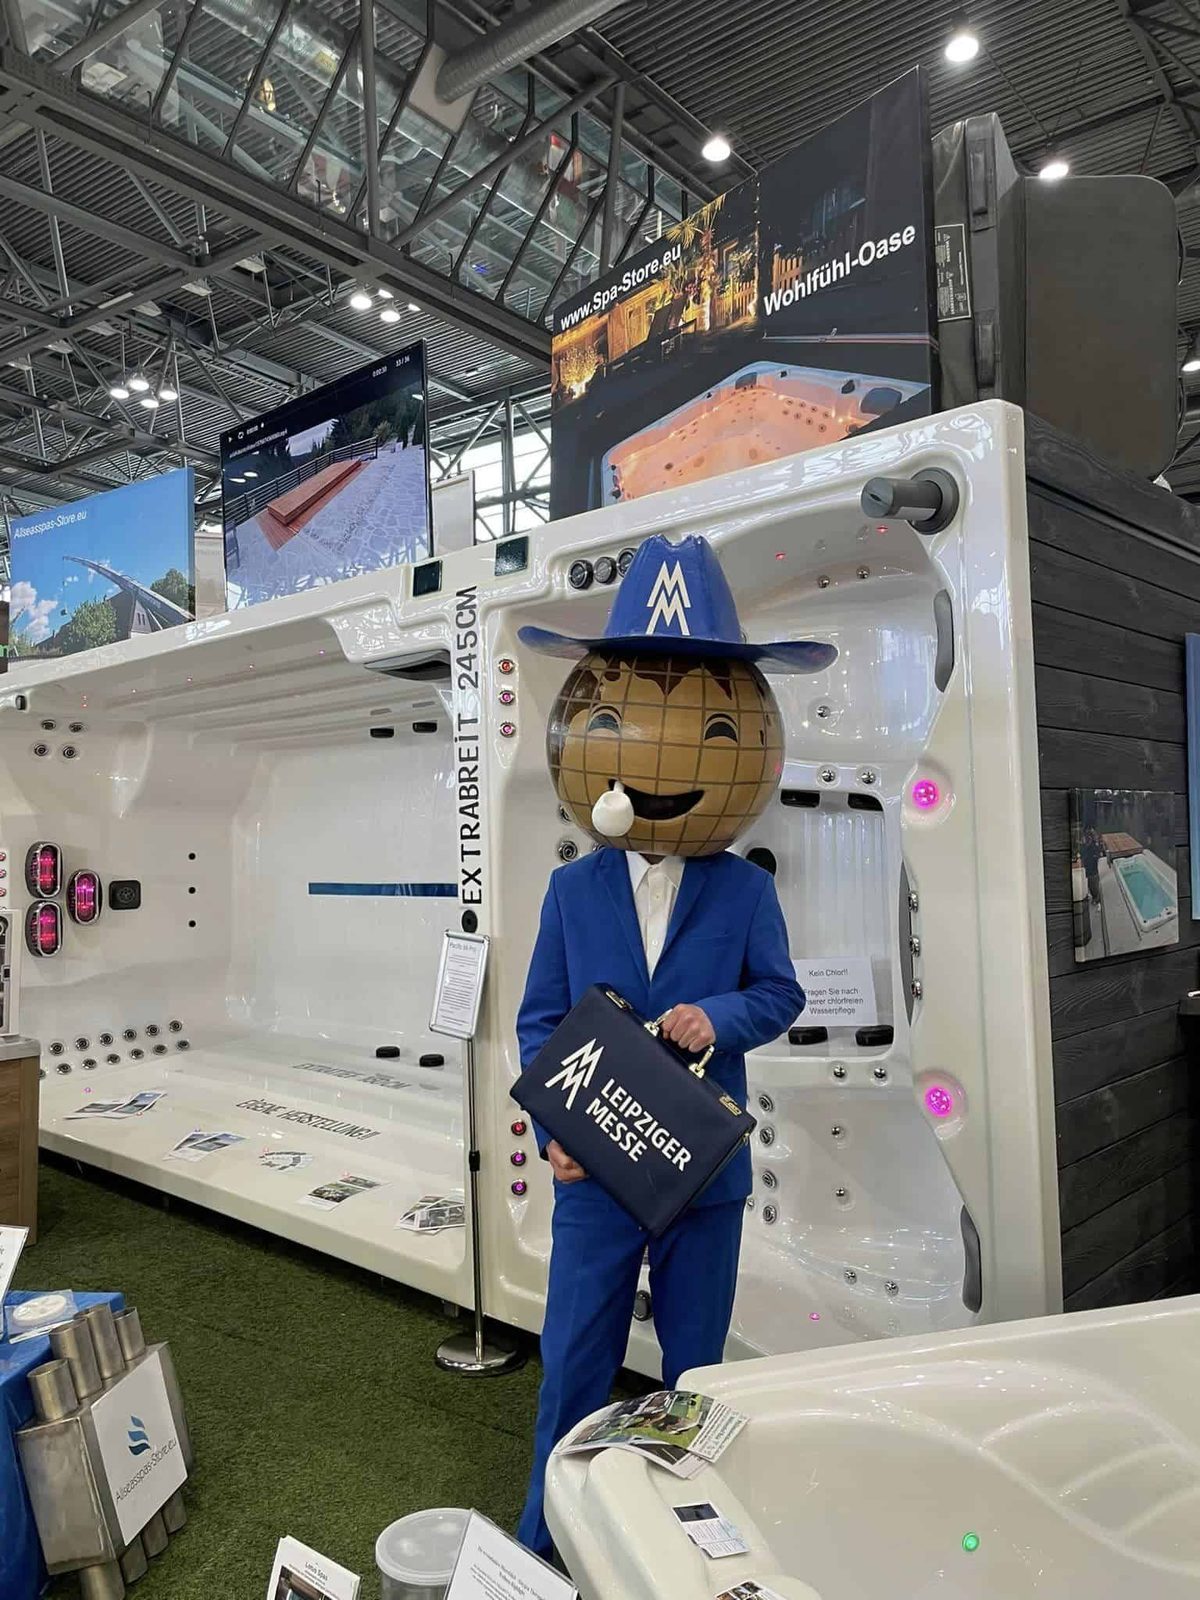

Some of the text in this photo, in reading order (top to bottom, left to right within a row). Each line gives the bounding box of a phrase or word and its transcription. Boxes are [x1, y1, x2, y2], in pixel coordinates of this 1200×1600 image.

[560, 242, 681, 331] www.Spa-Store.eu
[763, 223, 916, 316] Wohlfühl-Oase
[455, 585, 479, 691] 245CM
[809, 1007, 856, 1016] Wasserpflege
[828, 987, 840, 996] Sie
[841, 987, 859, 995] nach
[585, 1097, 647, 1162] MESSE
[601, 1078, 692, 1171] LEIPZIGER
